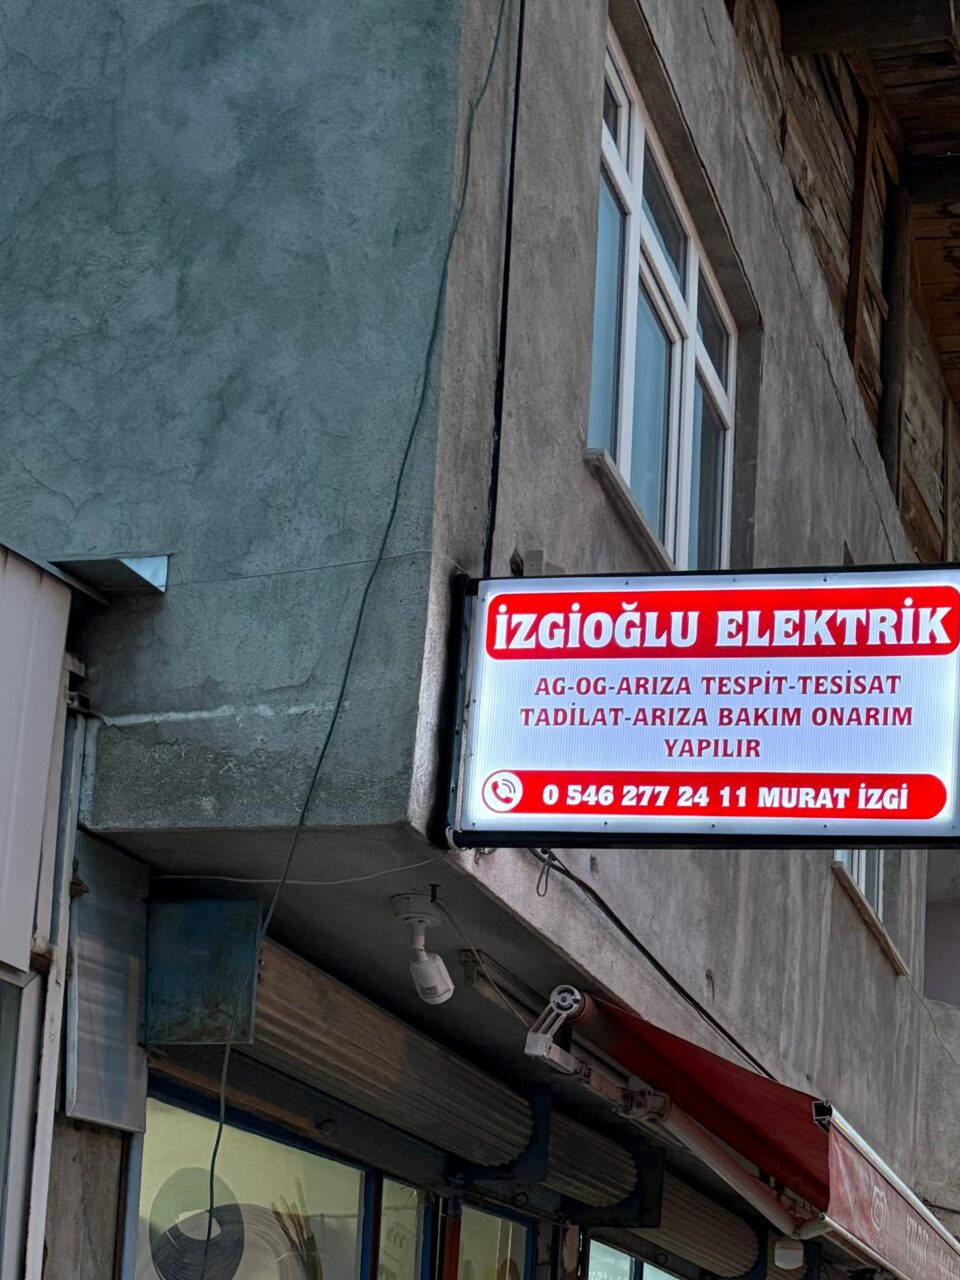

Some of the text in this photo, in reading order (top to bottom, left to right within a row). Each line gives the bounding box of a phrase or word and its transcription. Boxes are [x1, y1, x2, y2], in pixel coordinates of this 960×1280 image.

[493, 596, 952, 650] İZGİOĞLU ELEKTRİK
[534, 669, 902, 696] AG-OG-ARIZA TESPİT-TESİSAT
[520, 702, 913, 727] TADİLAT-ARIZA BAKIM ONARIM
[663, 738, 761, 758] YAPILIR
[542, 782, 909, 810] 0 546 277 24 11 MURAT İZGİ
